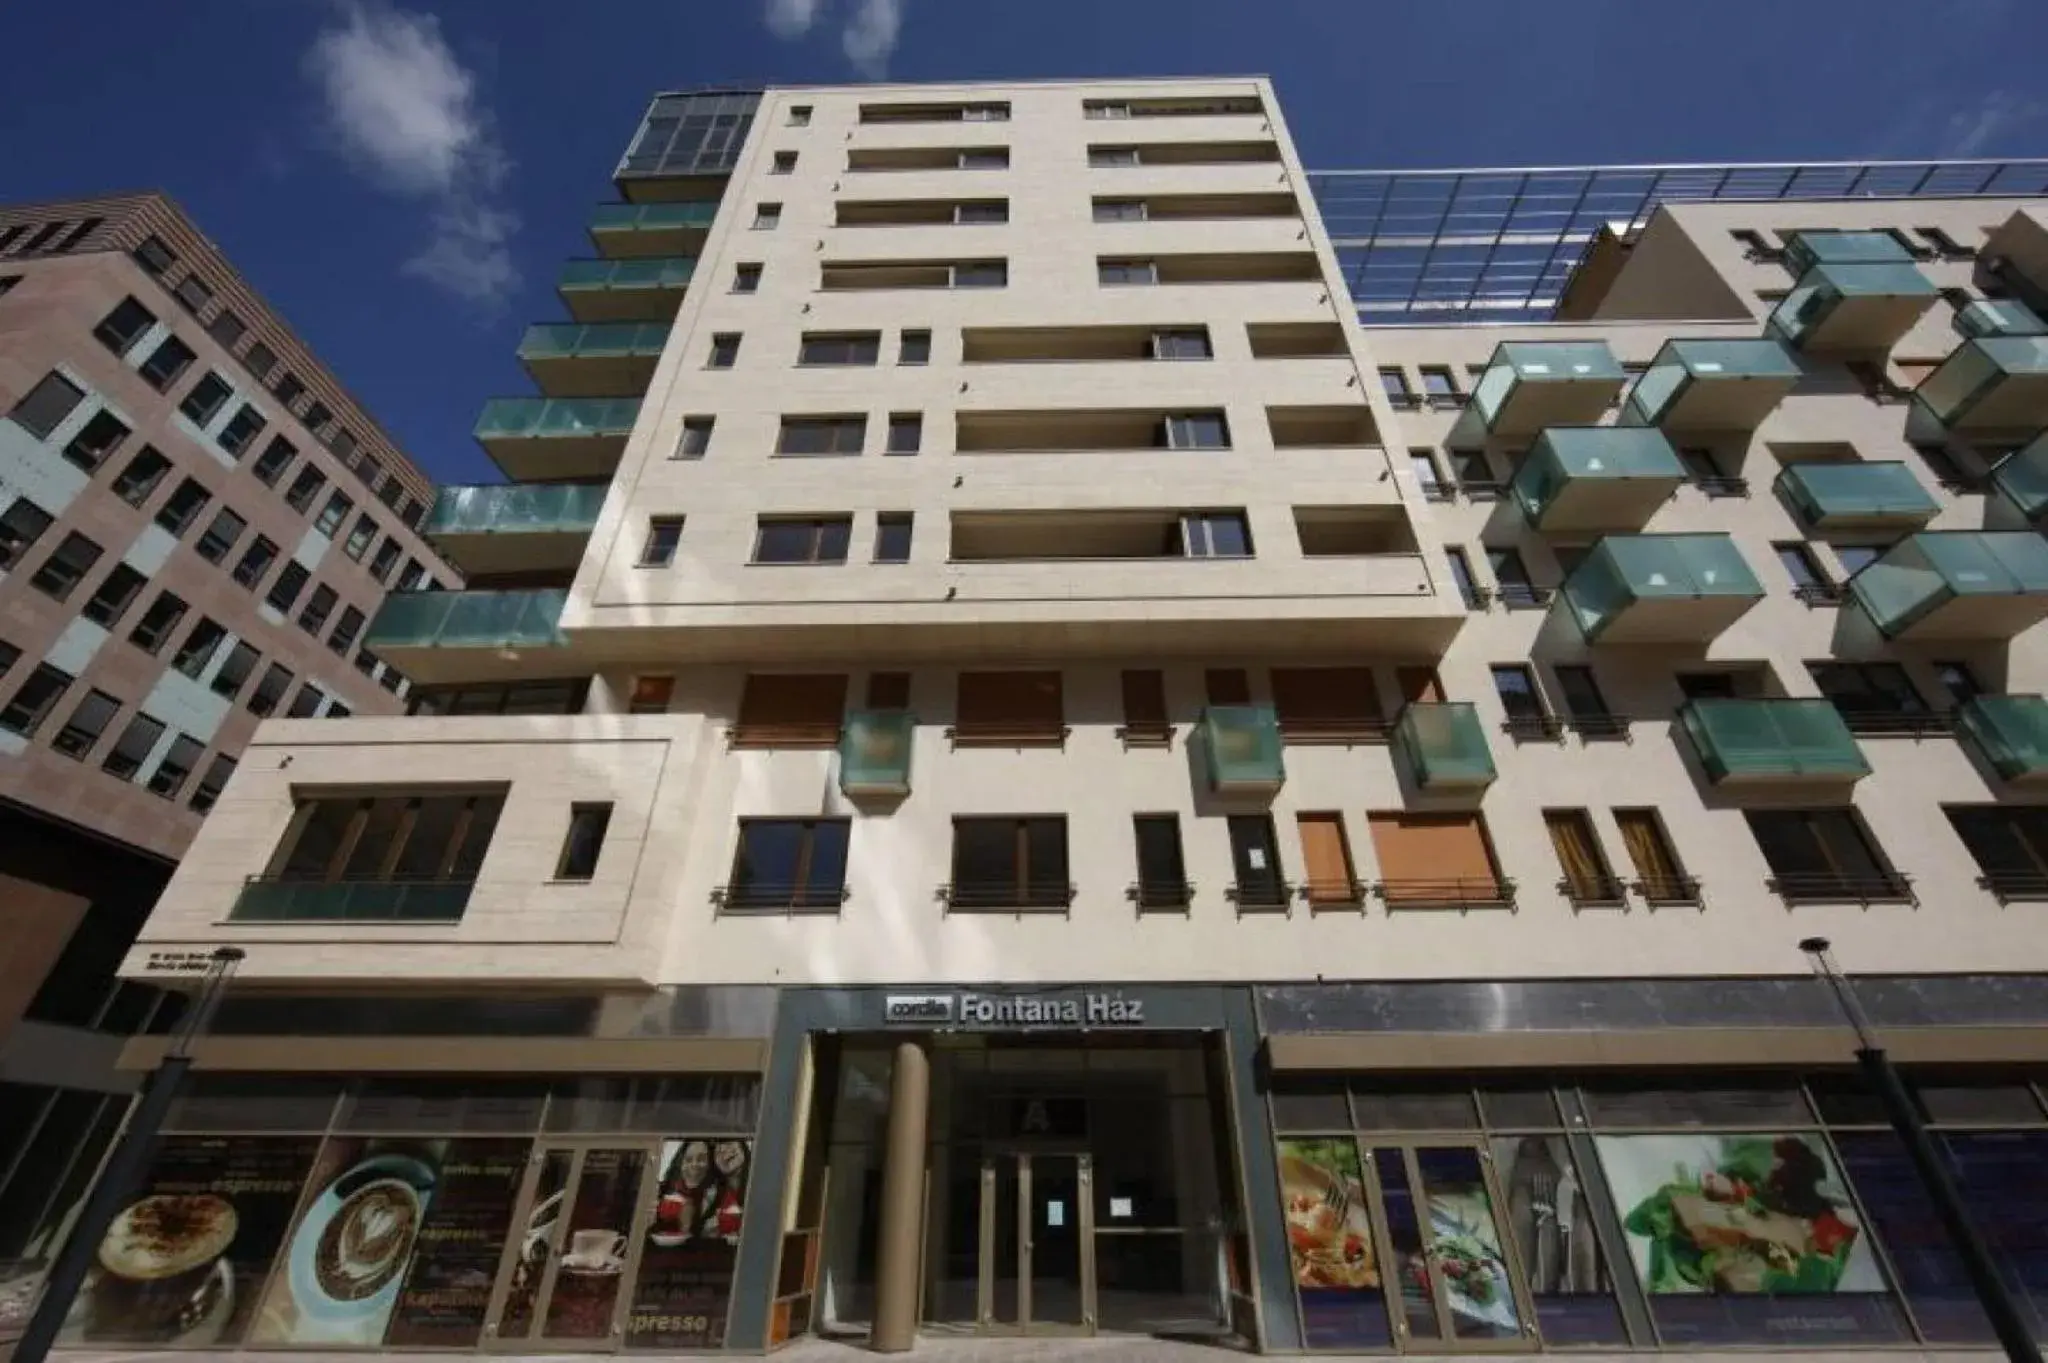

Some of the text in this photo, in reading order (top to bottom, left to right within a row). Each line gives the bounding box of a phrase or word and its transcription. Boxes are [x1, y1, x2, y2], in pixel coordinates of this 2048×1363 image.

[959, 995, 1077, 1021] Fontana
[1087, 990, 1145, 1021] Ház
[1022, 1101, 1052, 1131] A
